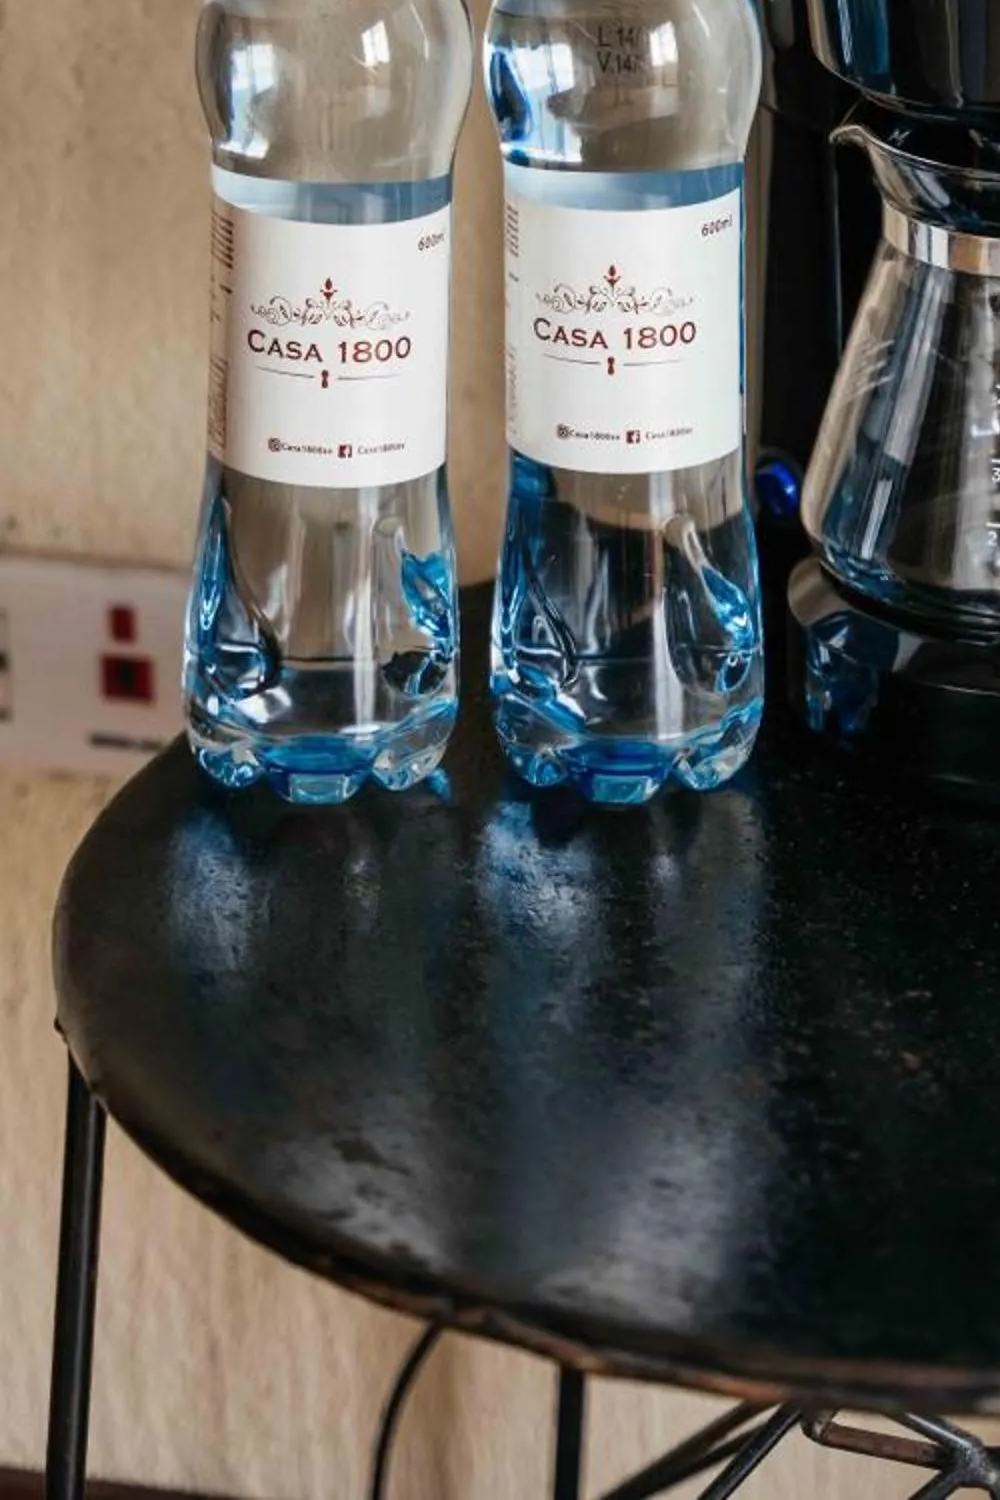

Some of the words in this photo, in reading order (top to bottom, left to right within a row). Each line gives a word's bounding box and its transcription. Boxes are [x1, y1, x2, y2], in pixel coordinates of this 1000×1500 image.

[701, 213, 733, 237] 600ml
[247, 329, 323, 363] CASA
[338, 337, 411, 363] 1800
[533, 317, 609, 349] CASA
[623, 321, 697, 349] 1800
[987, 530, 998, 547] 2
